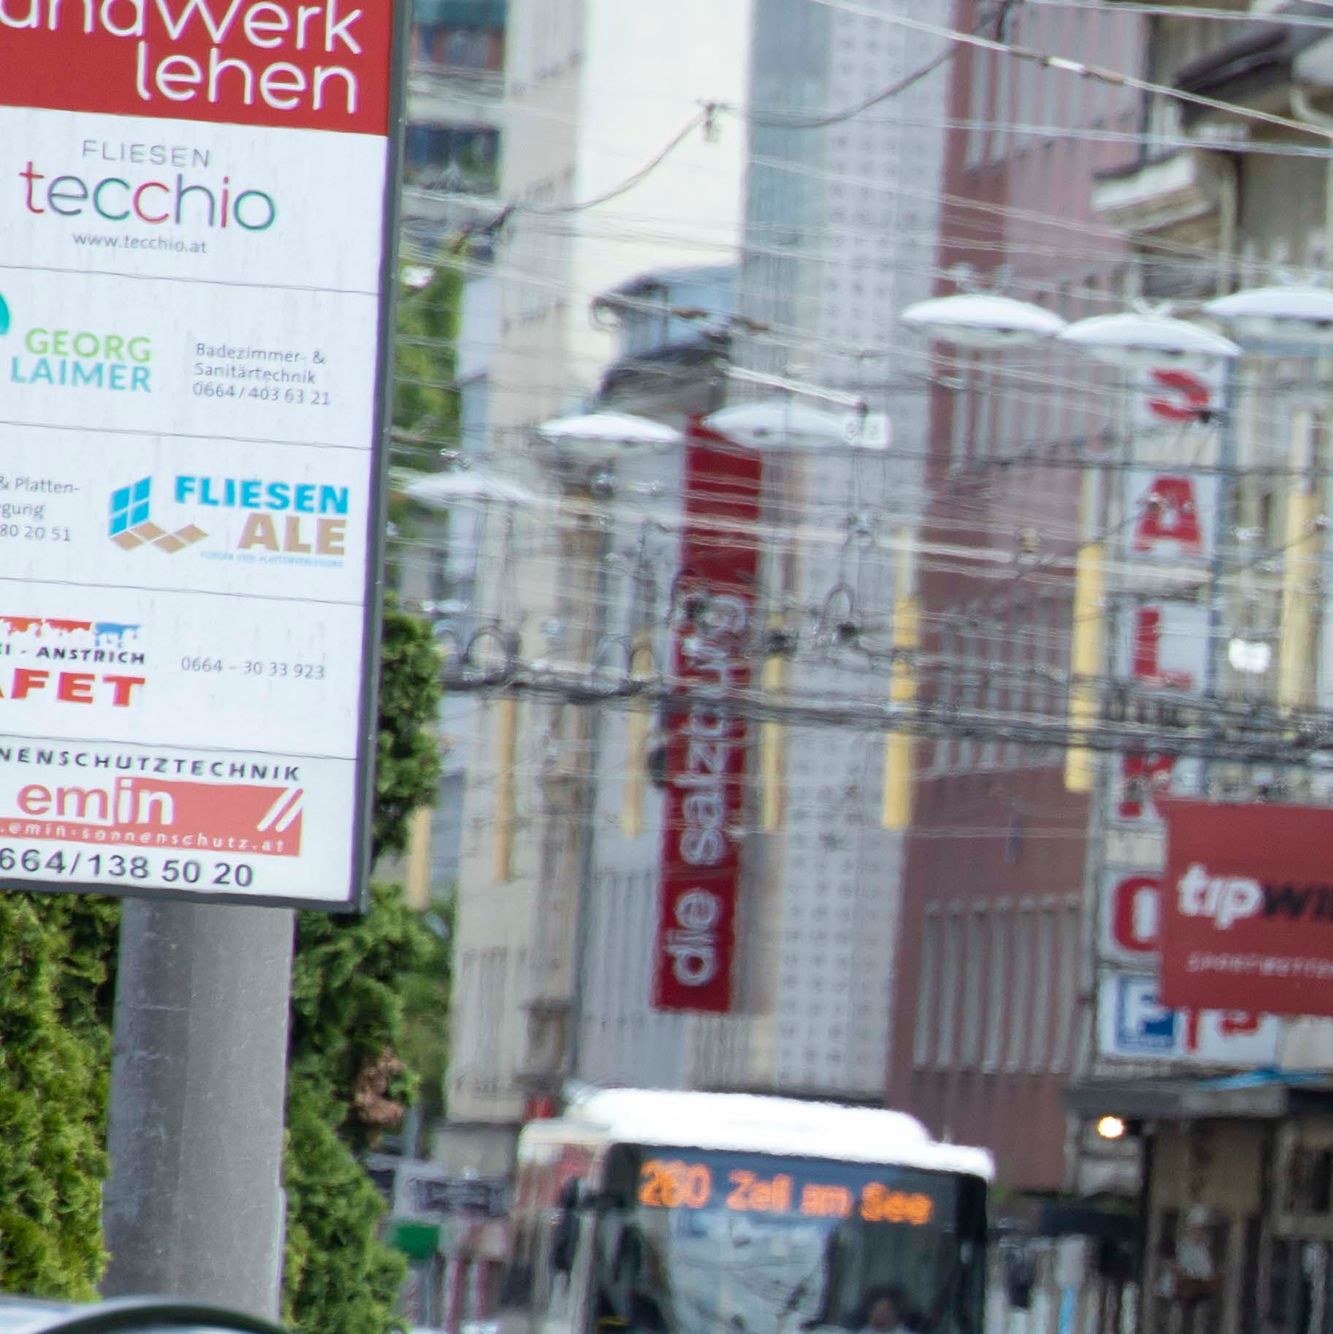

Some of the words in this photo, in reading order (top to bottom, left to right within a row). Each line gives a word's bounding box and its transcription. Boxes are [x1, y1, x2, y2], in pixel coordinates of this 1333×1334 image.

[136, 41, 358, 114] lehen
[82, 139, 211, 167] FLIESEN
[19, 161, 277, 231] tecchio
[72, 232, 208, 254] www.tecchio.at
[25, 328, 152, 363] GEORG
[11, 357, 152, 392] LAIMER
[194, 362, 316, 384] Sanitärtechnik
[192, 381, 236, 398] 0664
[311, 391, 331, 406] 21
[15, 477, 81, 495] Platten-
[173, 475, 349, 514] FLIESEN
[24, 525, 46, 541] 20
[52, 526, 71, 542] 51
[237, 512, 347, 555] ALE
[36, 646, 145, 665] ANSTRICH
[181, 656, 223, 672] 0664
[243, 660, 263, 676] 30
[269, 661, 288, 677] 33
[293, 663, 325, 680] 923
[0, 667, 146, 707] FET
[17, 777, 176, 826] emin
[0, 847, 149, 880] 664/138
[161, 858, 201, 884] 50
[212, 862, 254, 888] 20
[665, 887, 721, 987] die
[726, 1168, 793, 1213] Zell
